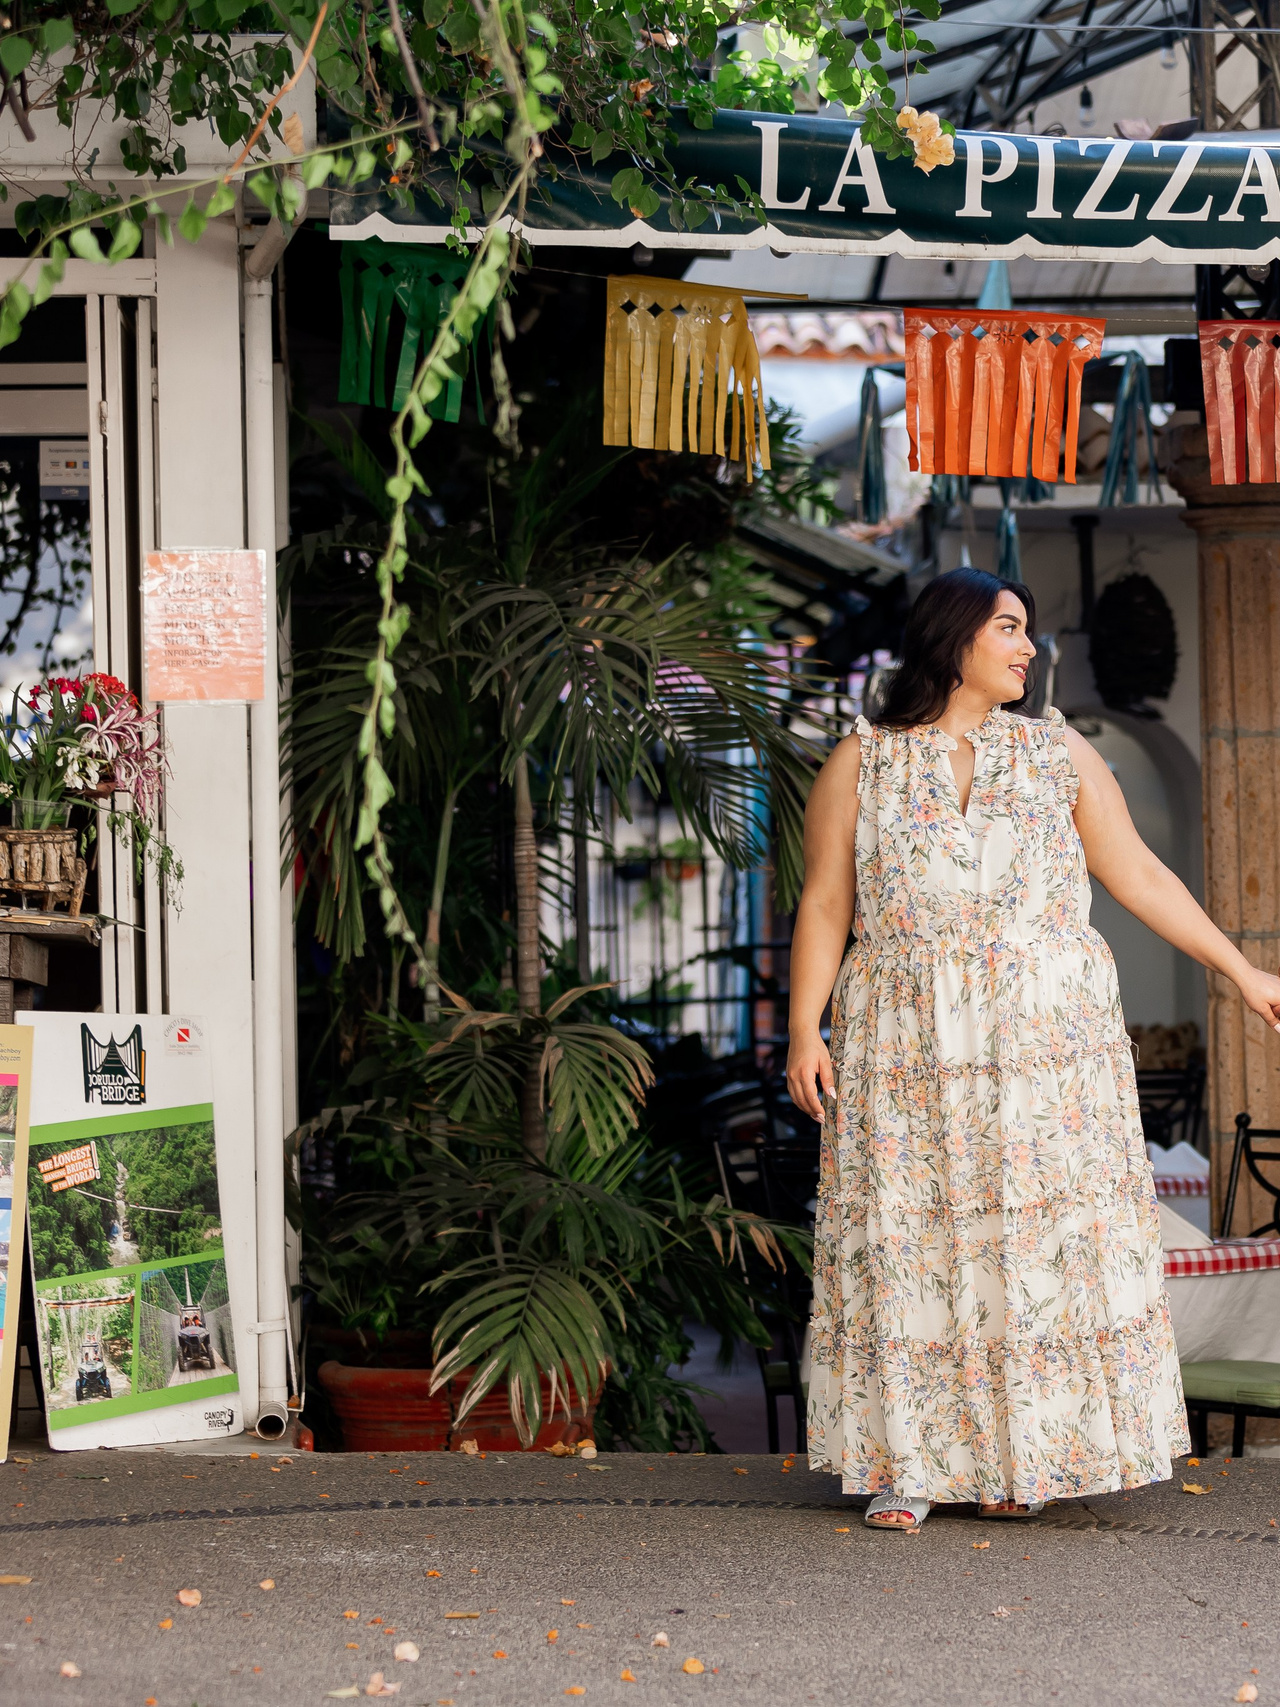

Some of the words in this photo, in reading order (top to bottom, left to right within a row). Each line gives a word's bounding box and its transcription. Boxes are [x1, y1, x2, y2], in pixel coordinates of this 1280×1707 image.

[749, 120, 897, 215] LA
[88, 1073, 124, 1088] JORULLO
[40, 1160, 53, 1173] THE
[52, 1145, 91, 1168] LONGEST
[65, 1158, 93, 1176] BRIDGE
[204, 1410, 227, 1420] CANOPY
[208, 1419, 225, 1428] RIVER
